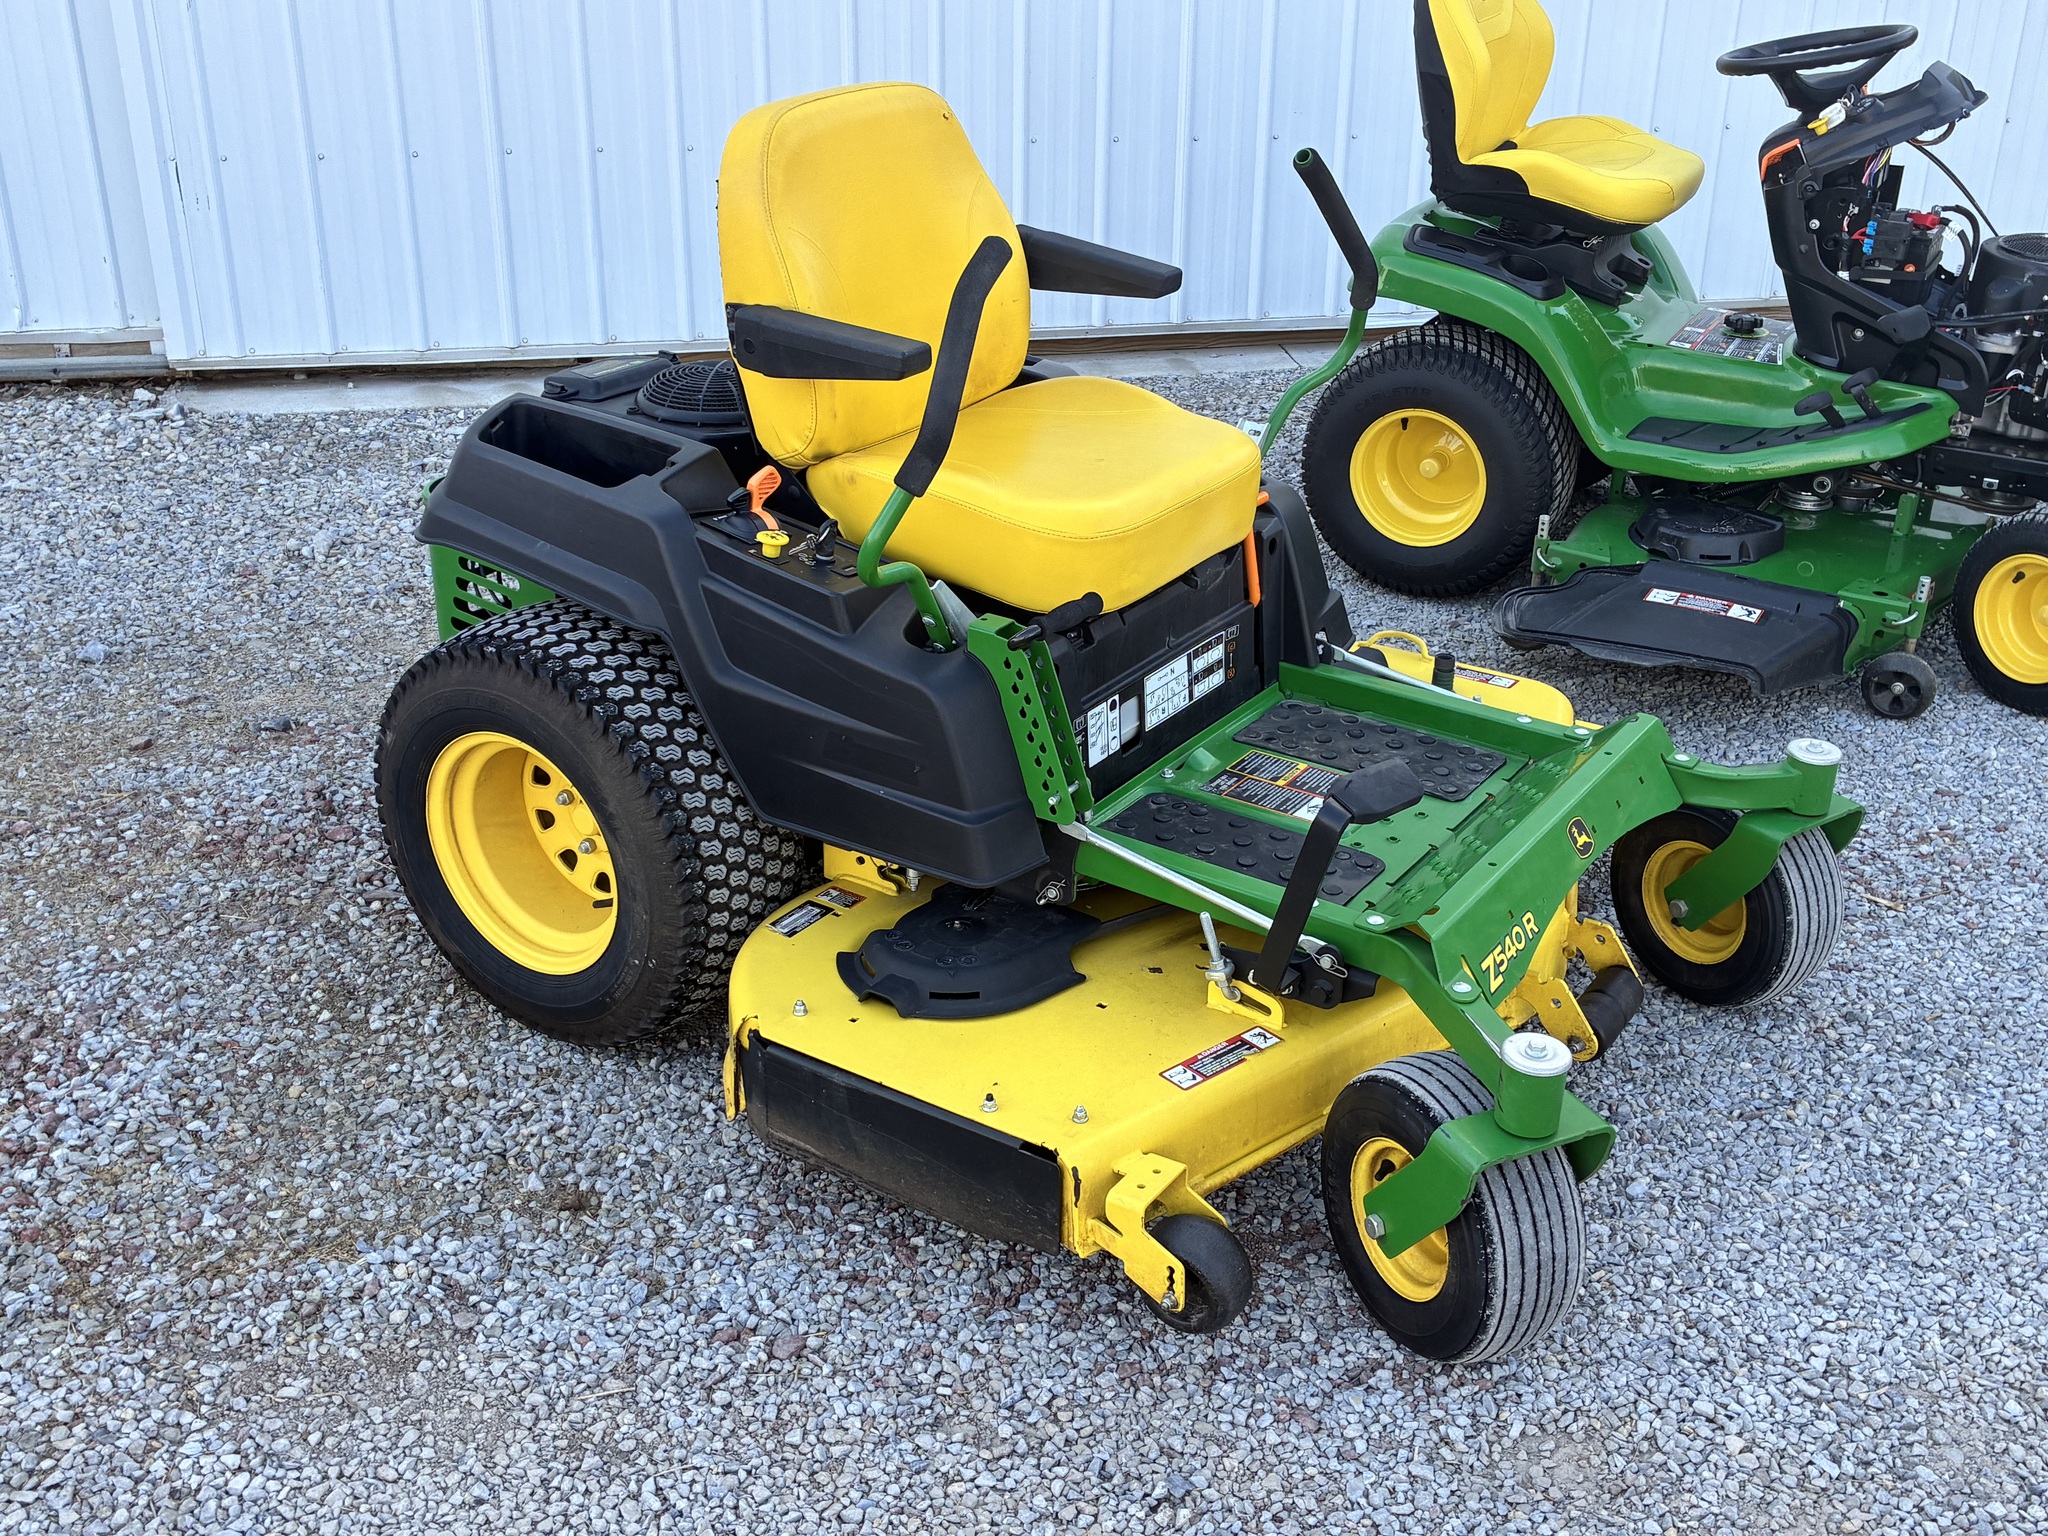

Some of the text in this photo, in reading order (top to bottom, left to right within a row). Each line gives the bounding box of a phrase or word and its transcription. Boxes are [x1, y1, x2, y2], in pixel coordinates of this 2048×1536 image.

[1694, 595, 1728, 605] DANGER
[1480, 910, 1540, 995] Z540 R
[1201, 1041, 1229, 1057] DANGER
